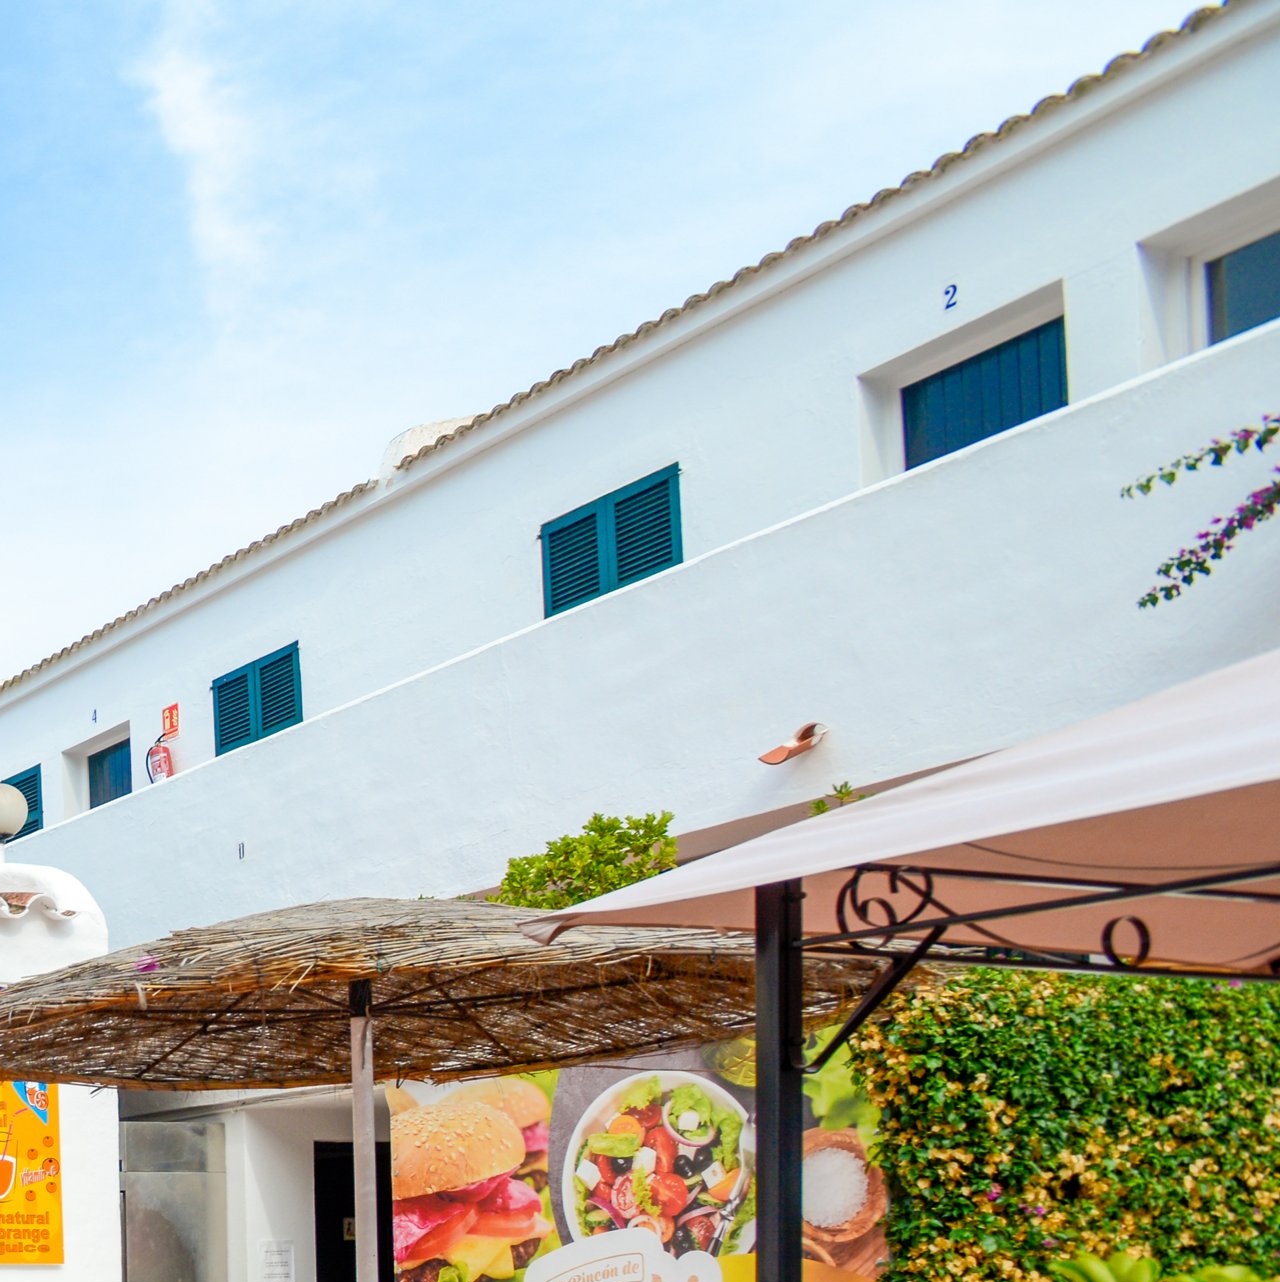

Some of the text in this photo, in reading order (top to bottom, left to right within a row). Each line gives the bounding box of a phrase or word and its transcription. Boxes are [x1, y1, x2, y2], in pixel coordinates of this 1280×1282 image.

[944, 284, 958, 310] 2
[92, 708, 98, 723] 4
[622, 1261, 640, 1276] de
